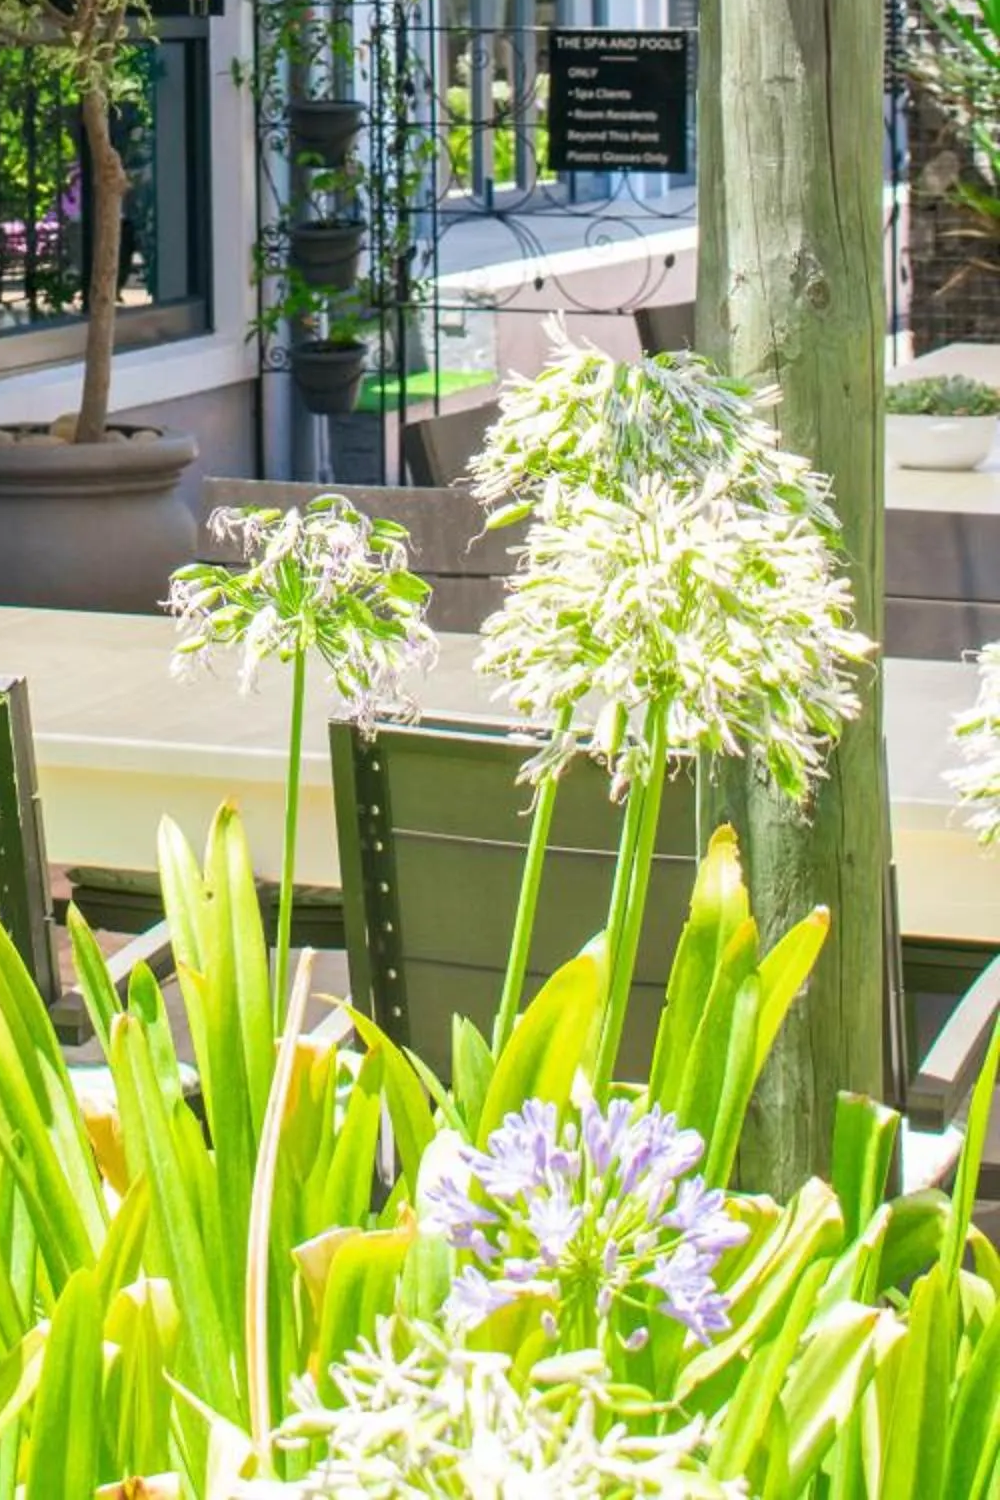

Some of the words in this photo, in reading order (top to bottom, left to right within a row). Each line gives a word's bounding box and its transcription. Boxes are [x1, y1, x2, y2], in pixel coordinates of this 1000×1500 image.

[556, 37, 581, 49] THE
[584, 37, 607, 49] SPA
[608, 37, 636, 50] AND
[639, 37, 683, 50] POOLS
[567, 67, 599, 79] ONLY
